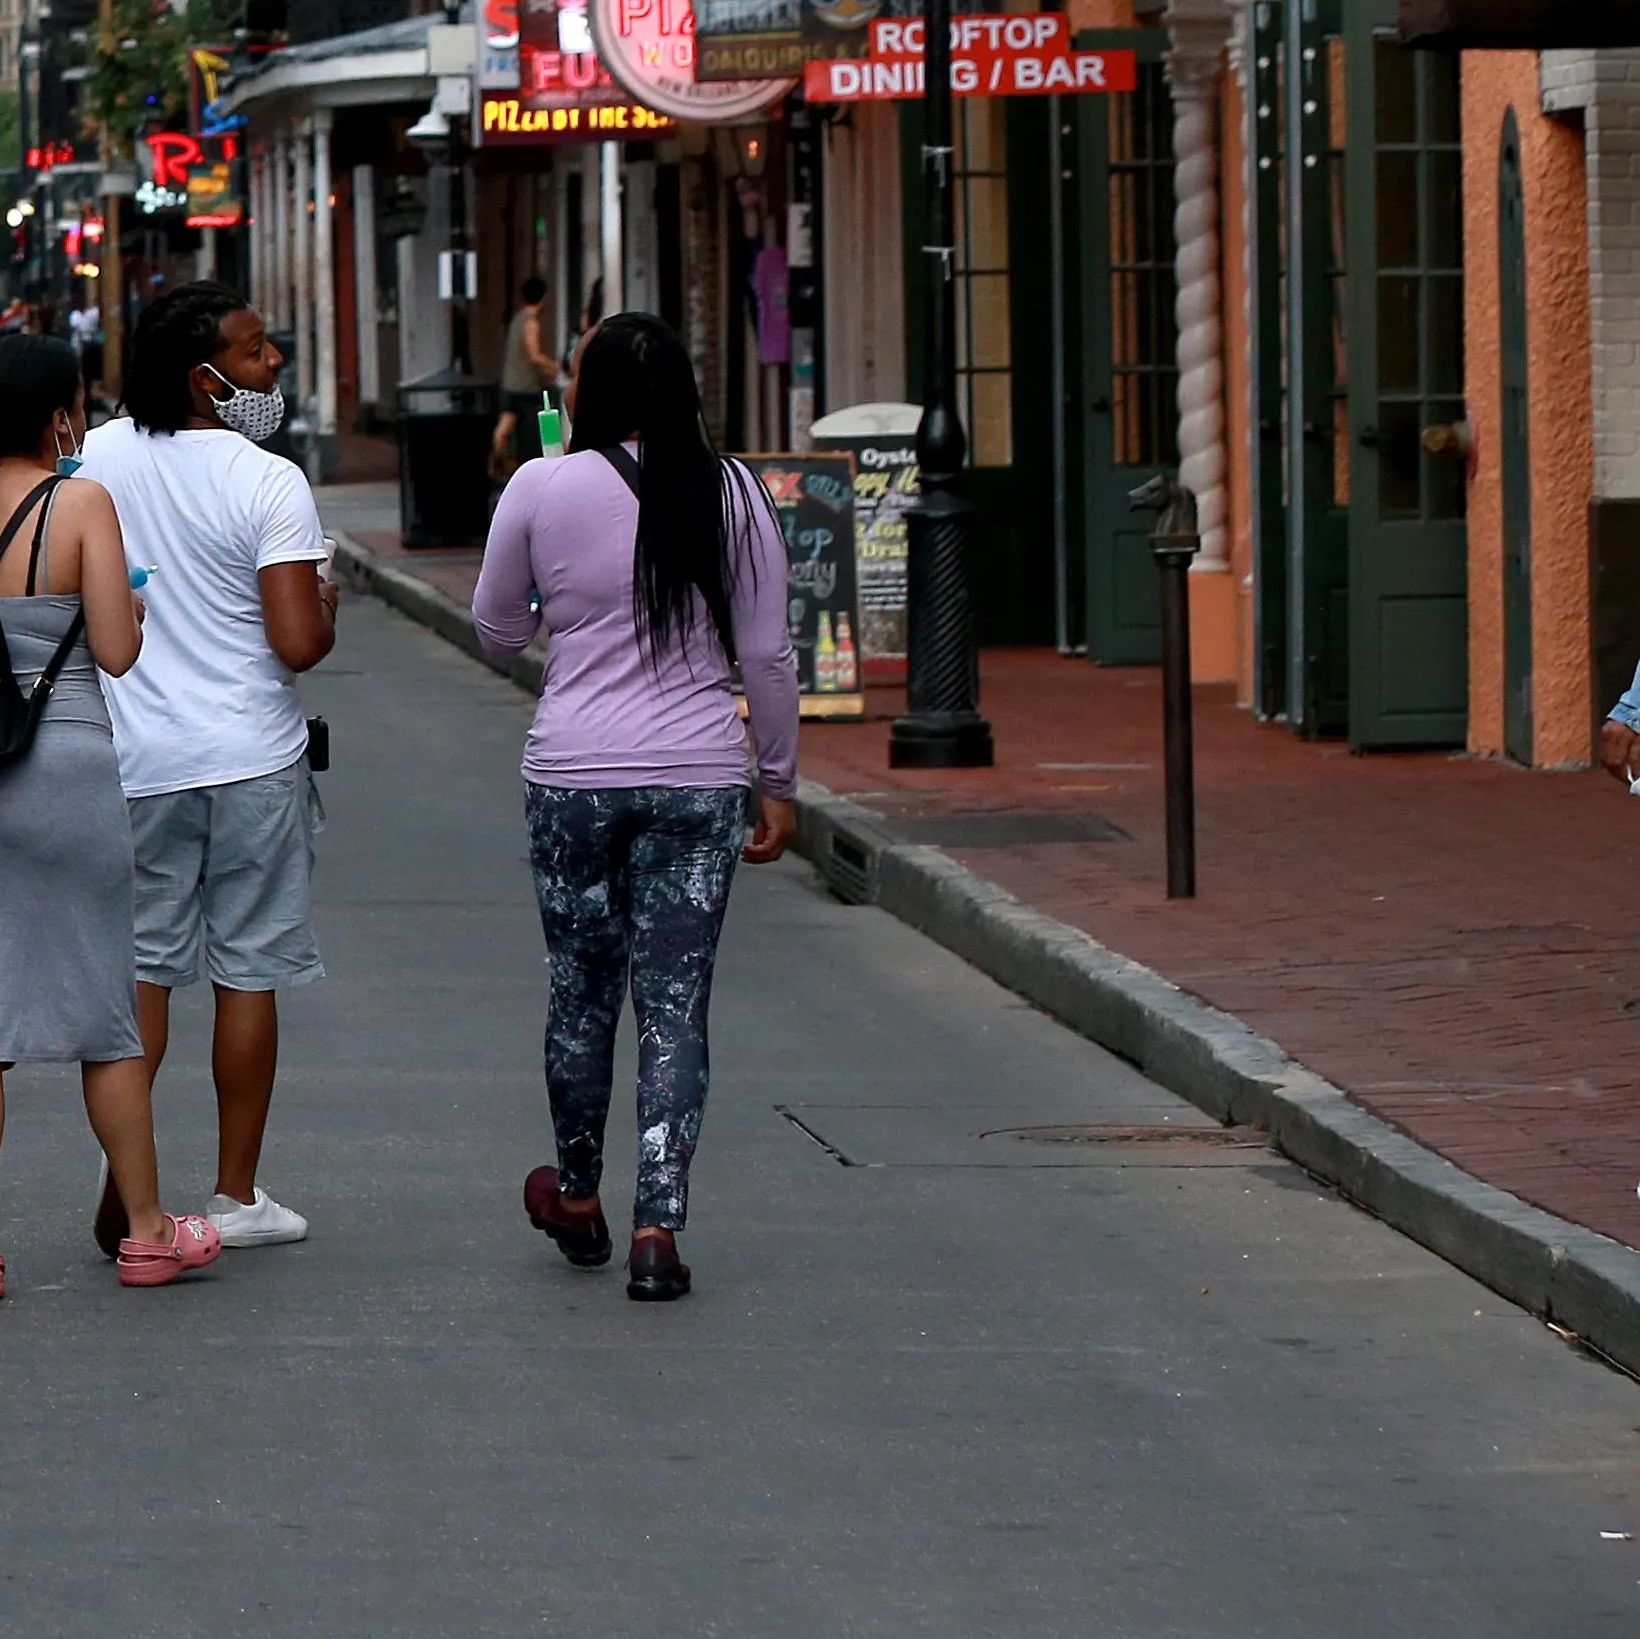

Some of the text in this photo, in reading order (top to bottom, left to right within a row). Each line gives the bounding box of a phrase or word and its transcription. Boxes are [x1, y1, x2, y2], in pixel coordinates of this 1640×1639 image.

[877, 16, 1059, 54] ROFTOP
[831, 54, 981, 95] DINIG
[1013, 50, 1105, 89] BAR
